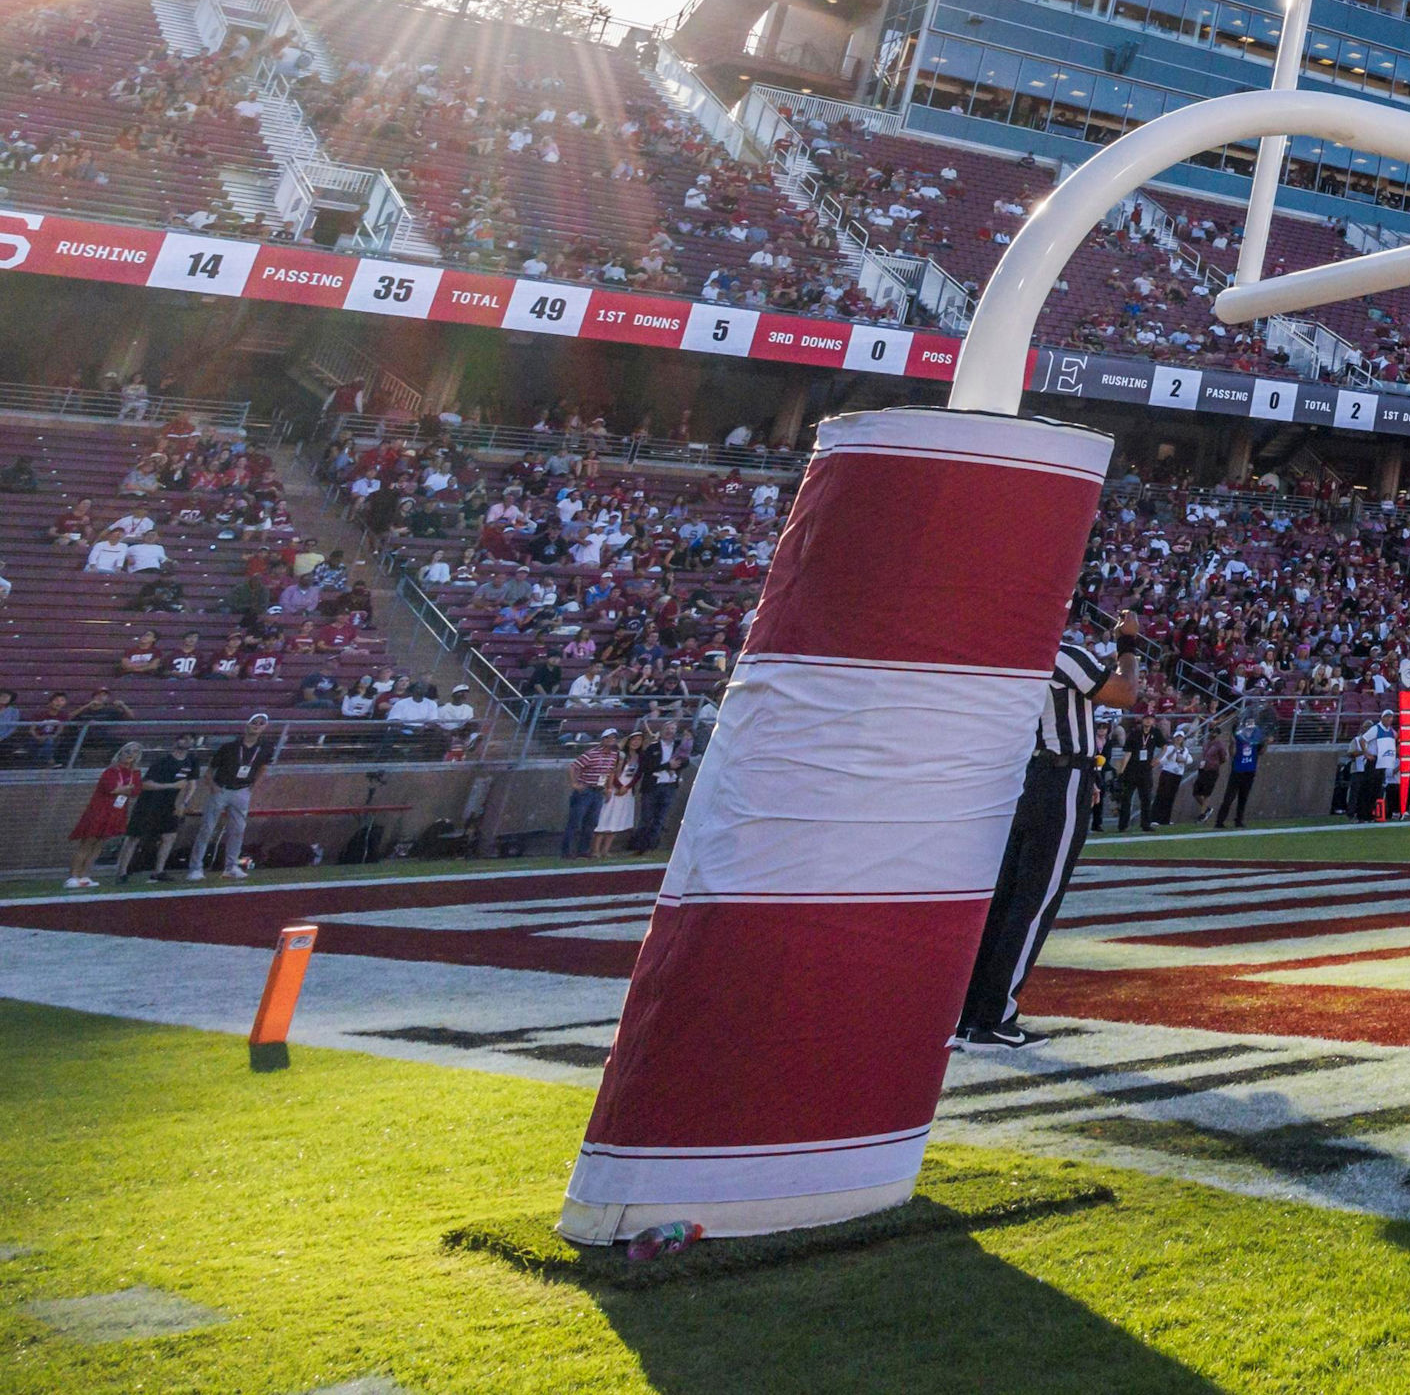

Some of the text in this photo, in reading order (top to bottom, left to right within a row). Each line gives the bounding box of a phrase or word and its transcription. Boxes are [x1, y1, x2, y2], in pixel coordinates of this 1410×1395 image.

[56, 240, 148, 265] RUSHING
[186, 251, 225, 280] 14
[262, 265, 344, 289] PASSING
[373, 275, 416, 304] 35
[450, 290, 500, 309] TOTAL
[529, 296, 567, 324] 49
[595, 308, 629, 325] 1ST
[633, 312, 681, 331] DOWNS
[711, 319, 730, 343] 5
[768, 330, 796, 347] 3RD
[800, 334, 844, 352] DOWNS
[870, 339, 887, 362] 0
[922, 350, 954, 366] POSS
[1101, 373, 1148, 390] RUSHING
[1169, 379, 1183, 398] 2
[1205, 387, 1249, 403] PASSING
[1269, 391, 1281, 410] 0
[1304, 399, 1332, 413] TOTAL
[1350, 402, 1361, 420] 2
[1382, 410, 1400, 421] 1ST
[172, 657, 197, 674] 30
